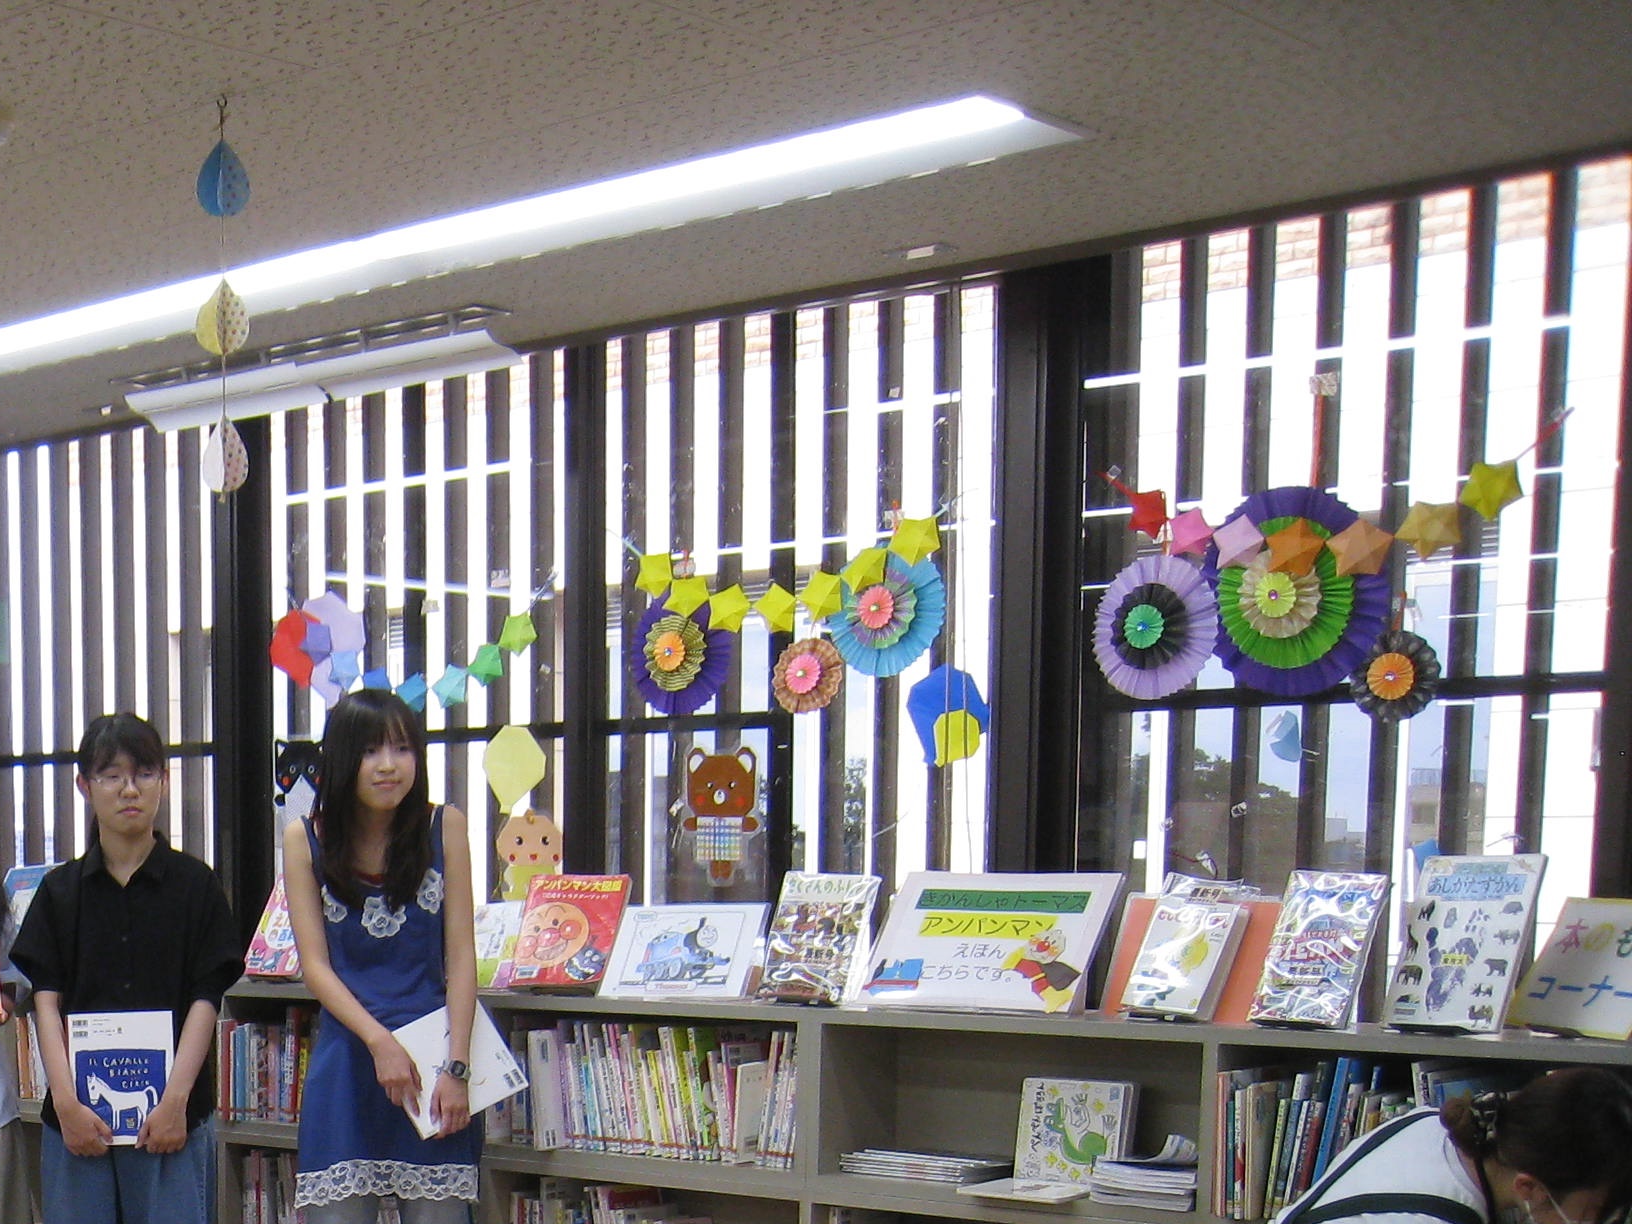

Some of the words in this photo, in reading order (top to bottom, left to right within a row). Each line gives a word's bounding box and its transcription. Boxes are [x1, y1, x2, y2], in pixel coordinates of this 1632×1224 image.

[919, 893, 1089, 911] きかんしゃトーマス
[920, 916, 1052, 937] アンパンマン
[952, 943, 1006, 959] えほん
